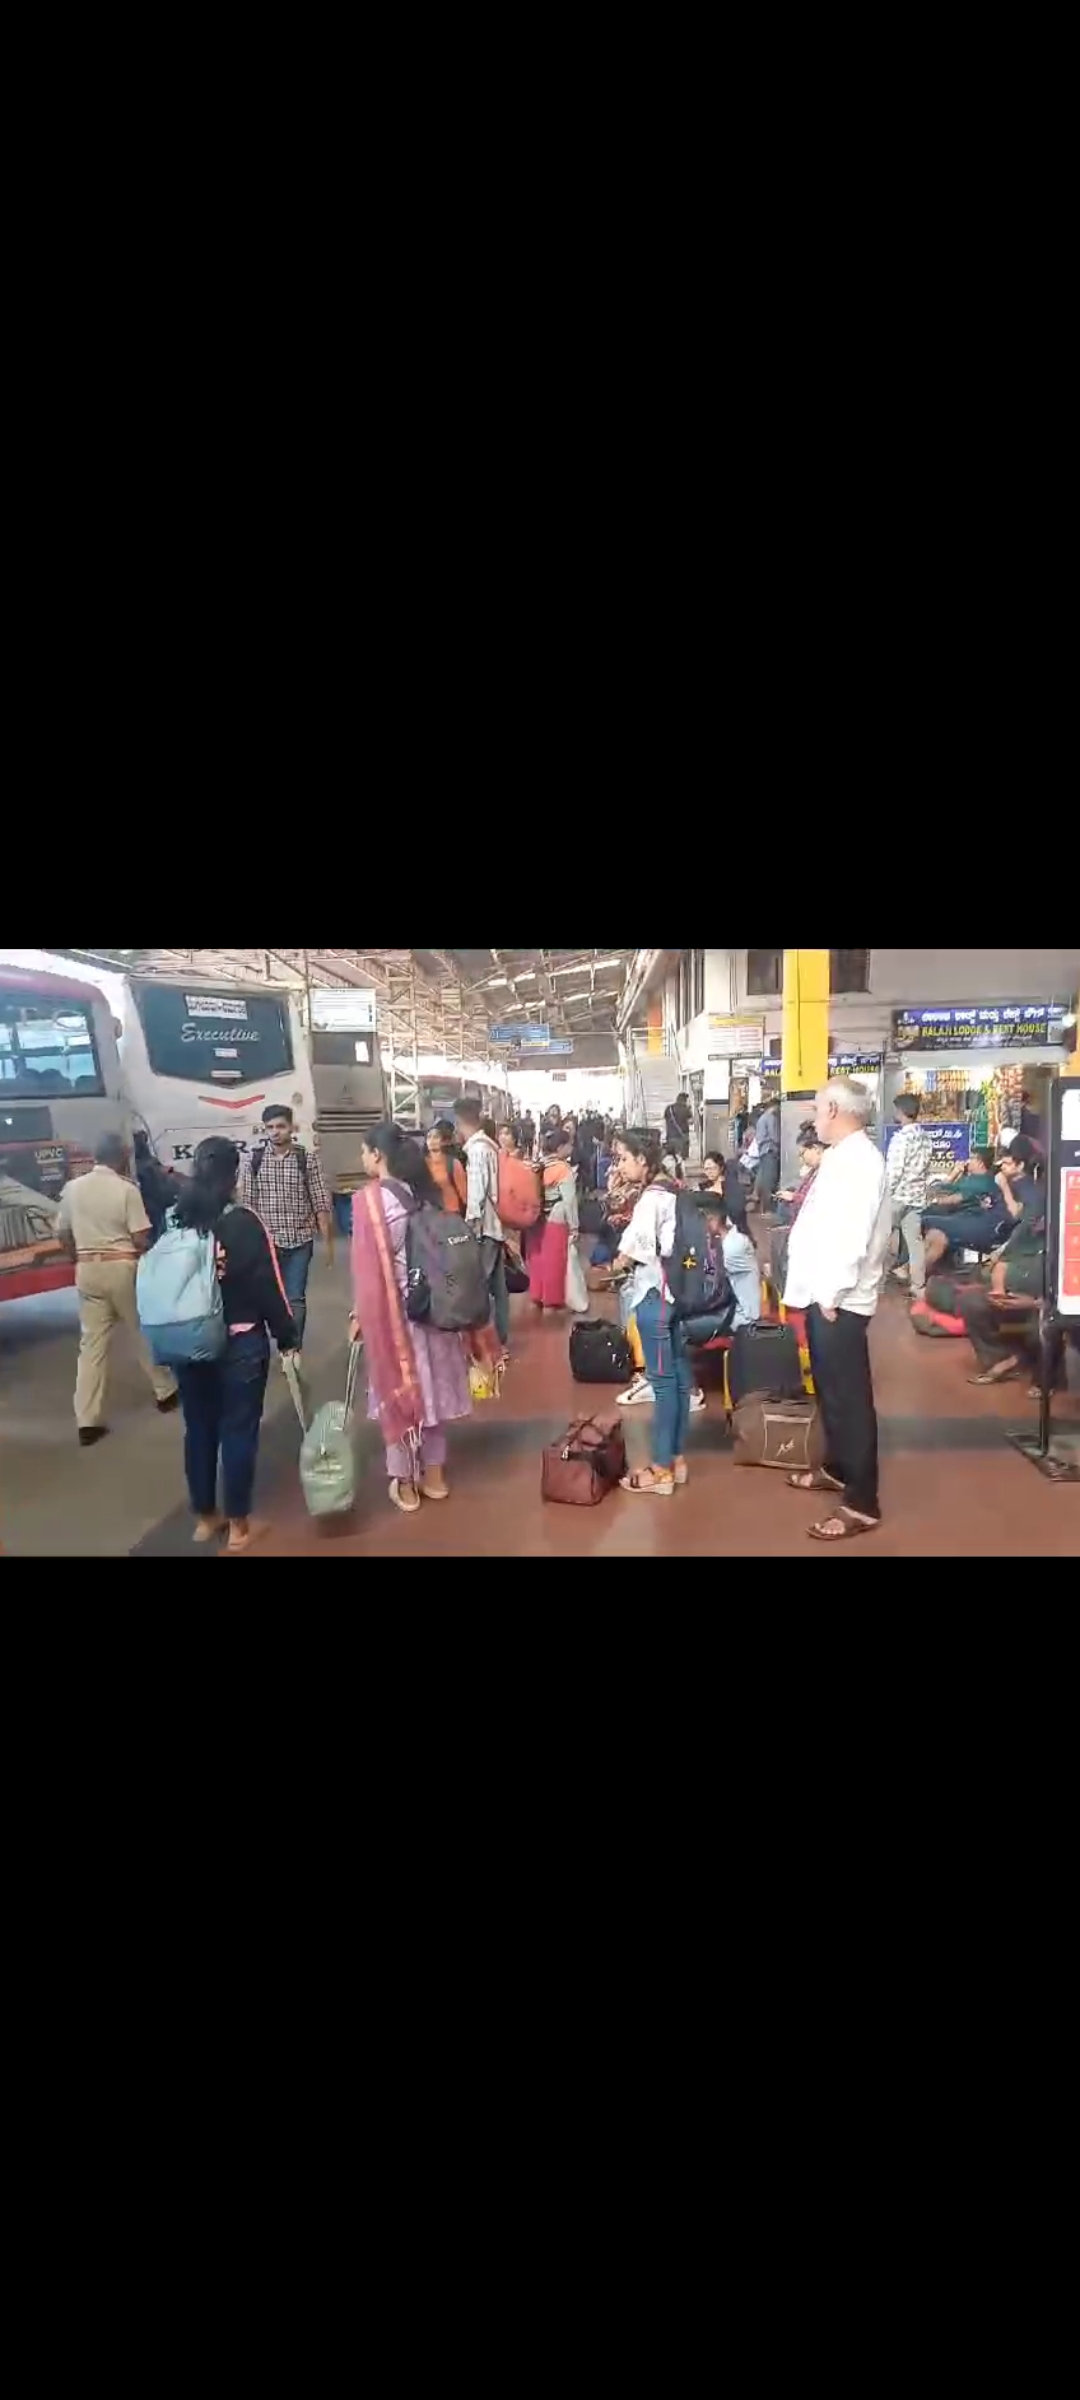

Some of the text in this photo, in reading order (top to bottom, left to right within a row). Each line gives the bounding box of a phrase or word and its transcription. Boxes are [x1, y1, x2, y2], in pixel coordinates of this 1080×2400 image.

[181, 1022, 260, 1042] Executive
[922, 1026, 952, 1036] BALAJI
[954, 1025, 981, 1036] LODGE
[1016, 1023, 1047, 1033] HOUSE
